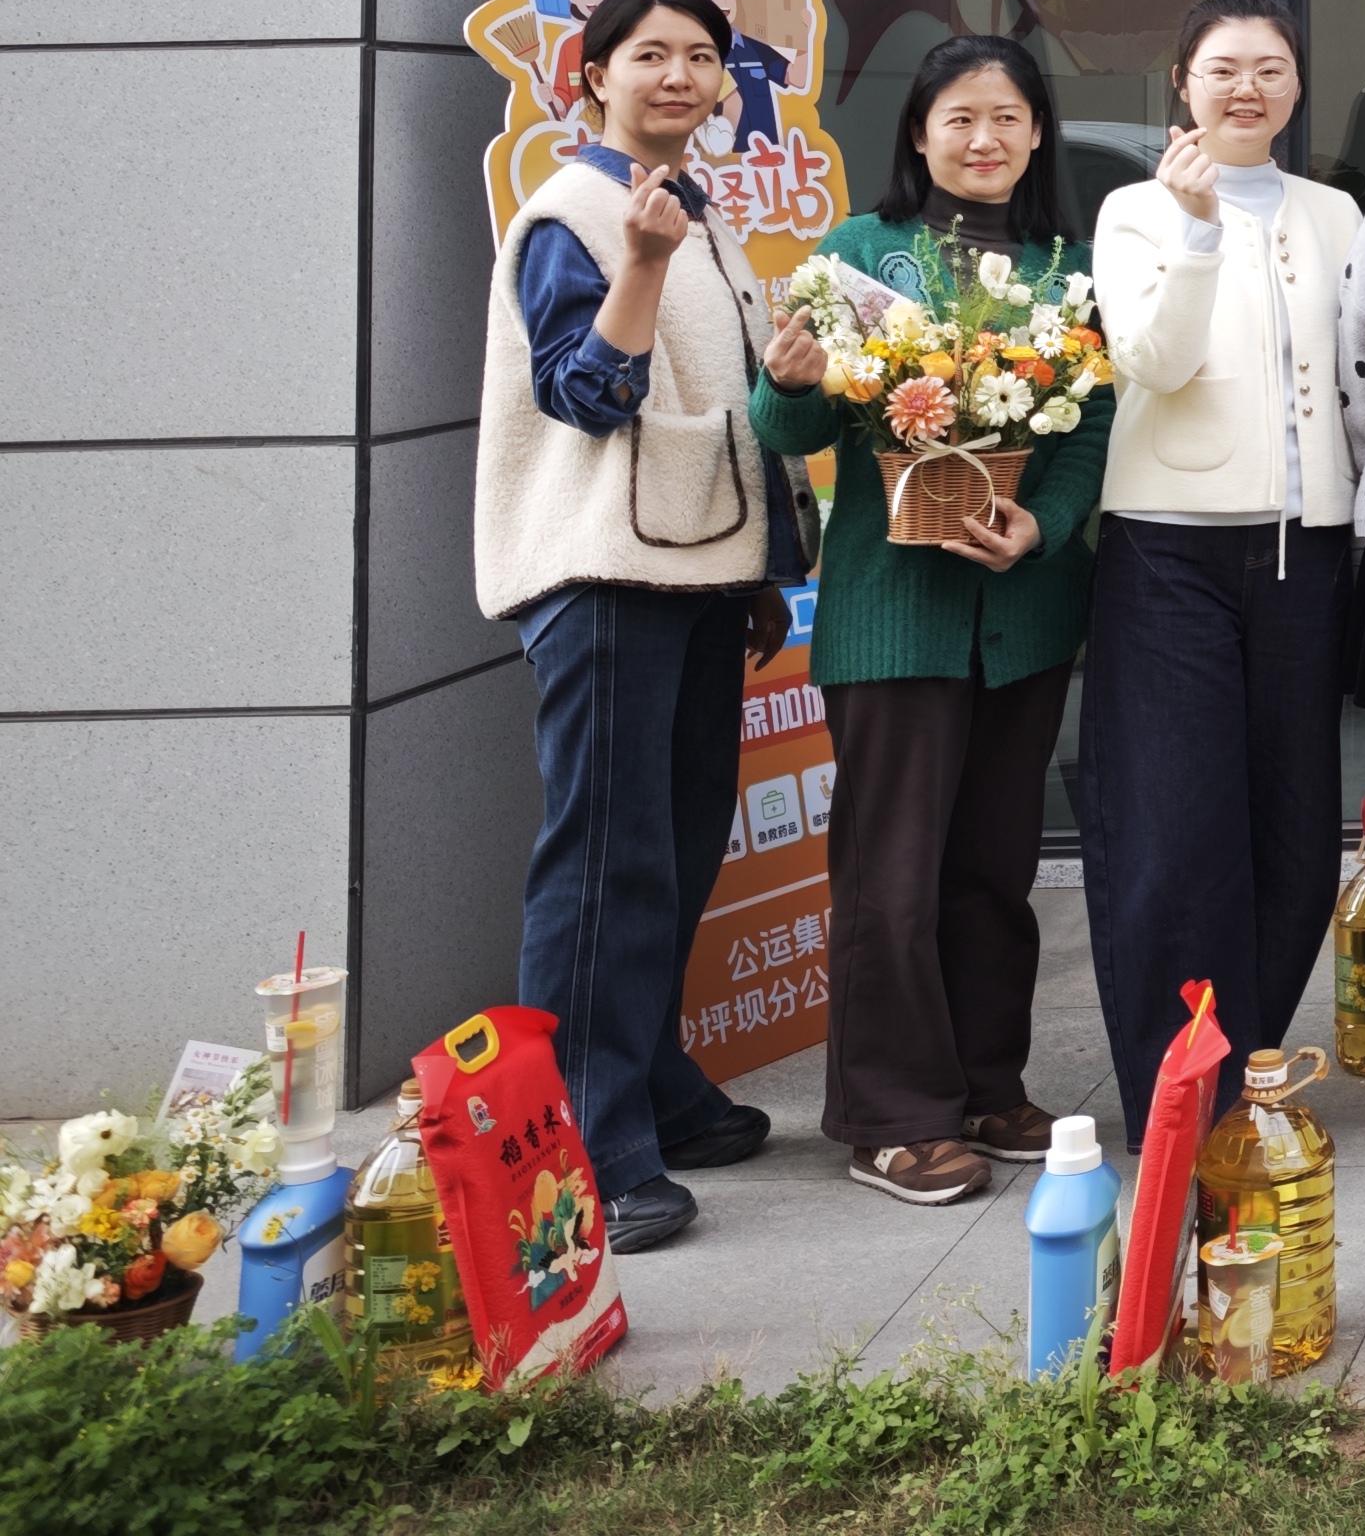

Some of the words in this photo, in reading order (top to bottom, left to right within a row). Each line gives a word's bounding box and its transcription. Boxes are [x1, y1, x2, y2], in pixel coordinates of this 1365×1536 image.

[757, 821, 798, 845] 急救药品
[500, 1104, 562, 1168] 稻香米
